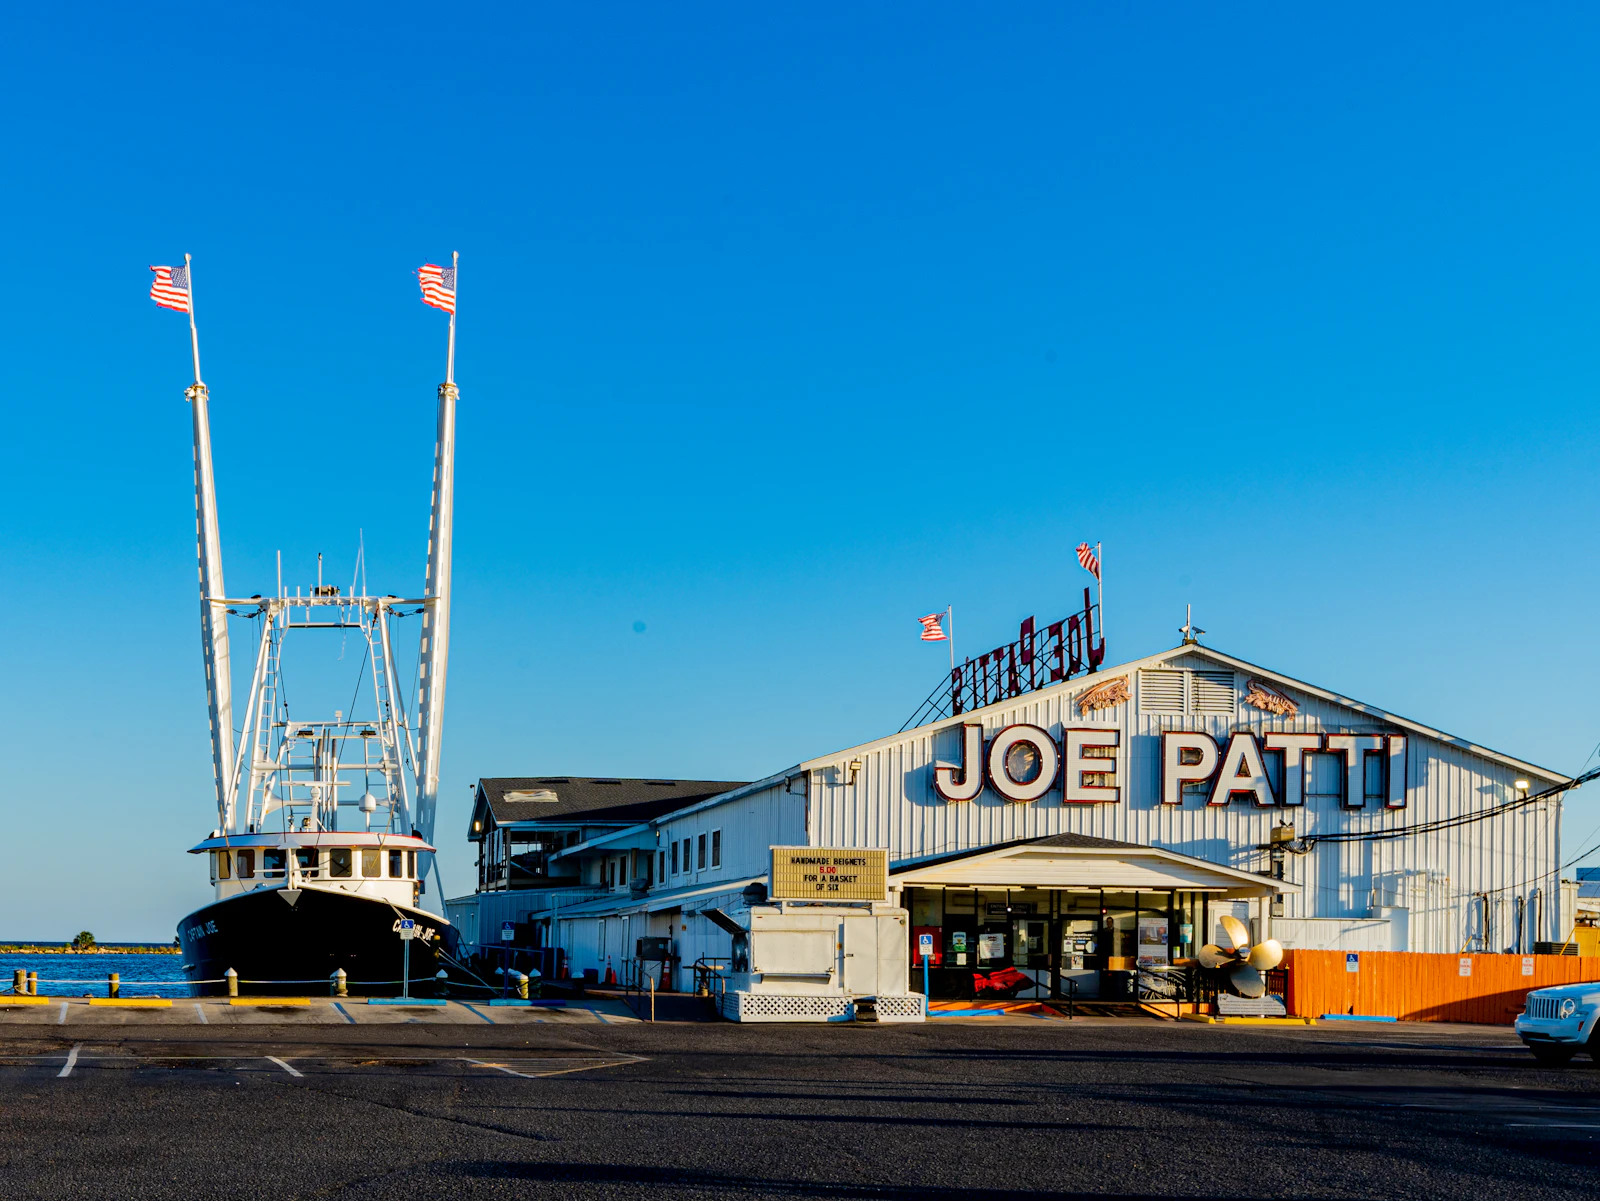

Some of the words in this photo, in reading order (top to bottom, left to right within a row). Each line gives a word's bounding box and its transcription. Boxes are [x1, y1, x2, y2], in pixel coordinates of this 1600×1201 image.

[933, 723, 1121, 803] JOE
[1161, 731, 1408, 809] PATTI
[791, 857, 830, 865] HANDMADE
[833, 858, 866, 866] BEIGNETS
[819, 866, 837, 874] 5.00
[829, 875, 858, 883] BASKET
[204, 920, 219, 935] JOE
